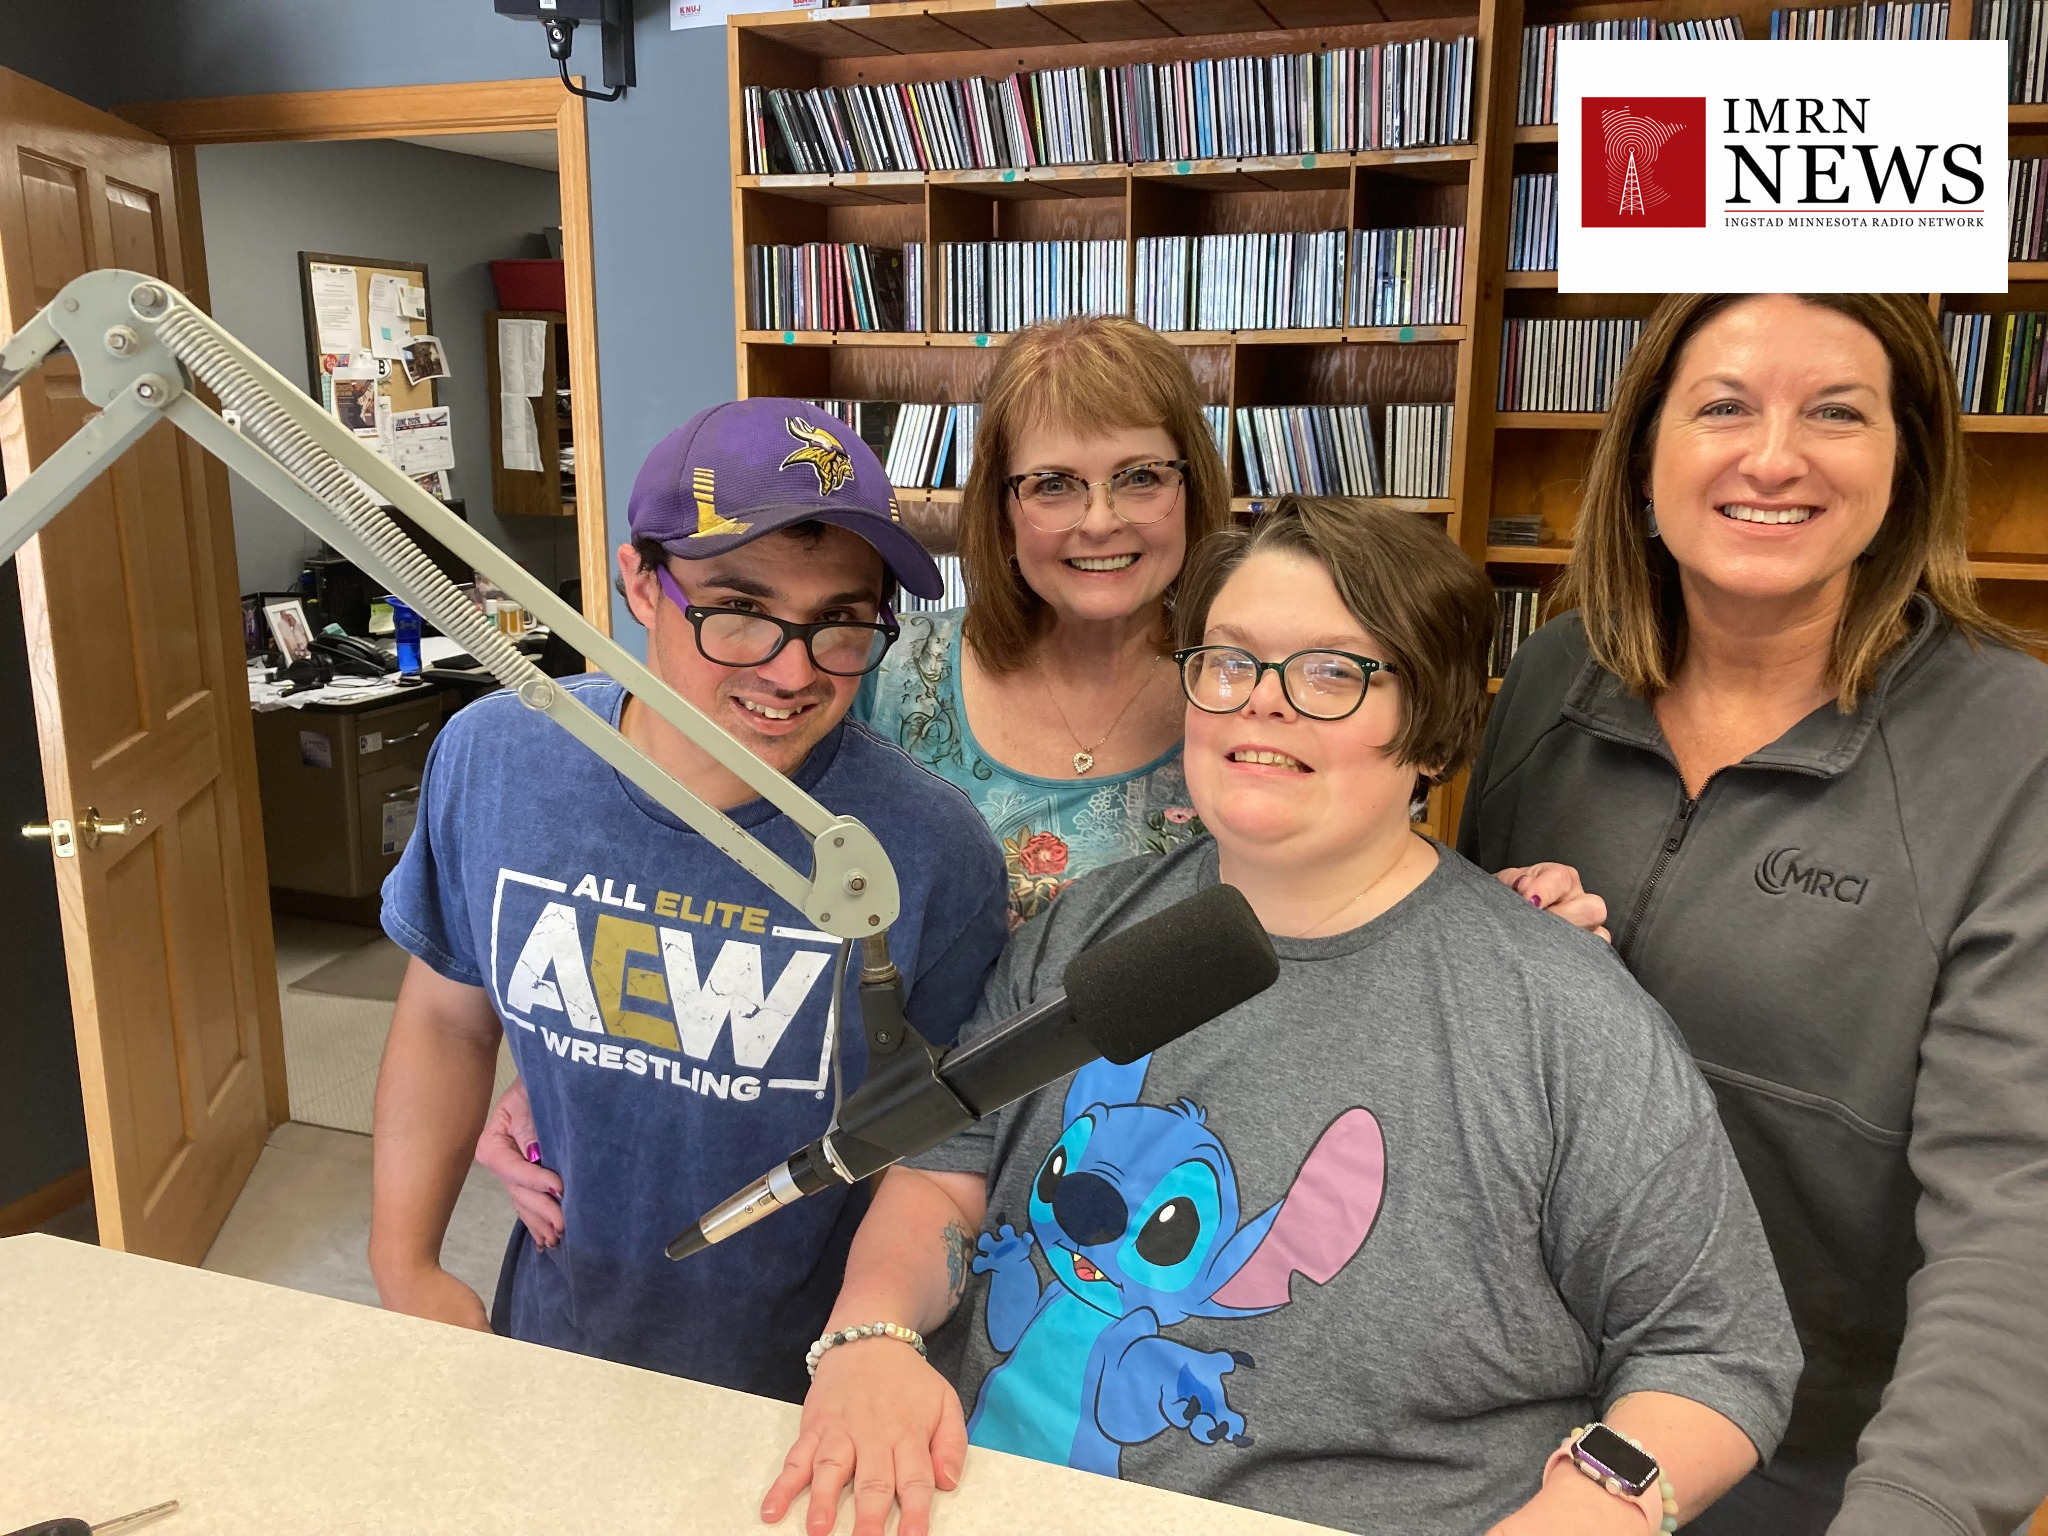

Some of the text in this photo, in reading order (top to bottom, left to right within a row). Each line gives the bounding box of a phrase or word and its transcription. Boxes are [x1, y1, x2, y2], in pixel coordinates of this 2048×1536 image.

[679, 5, 701, 14] KNUJ
[571, 873, 770, 935] ALL ELITE
[1780, 861, 1870, 905] MRCI
[507, 901, 832, 1069] AEW
[539, 1027, 761, 1102] WRESTLING
